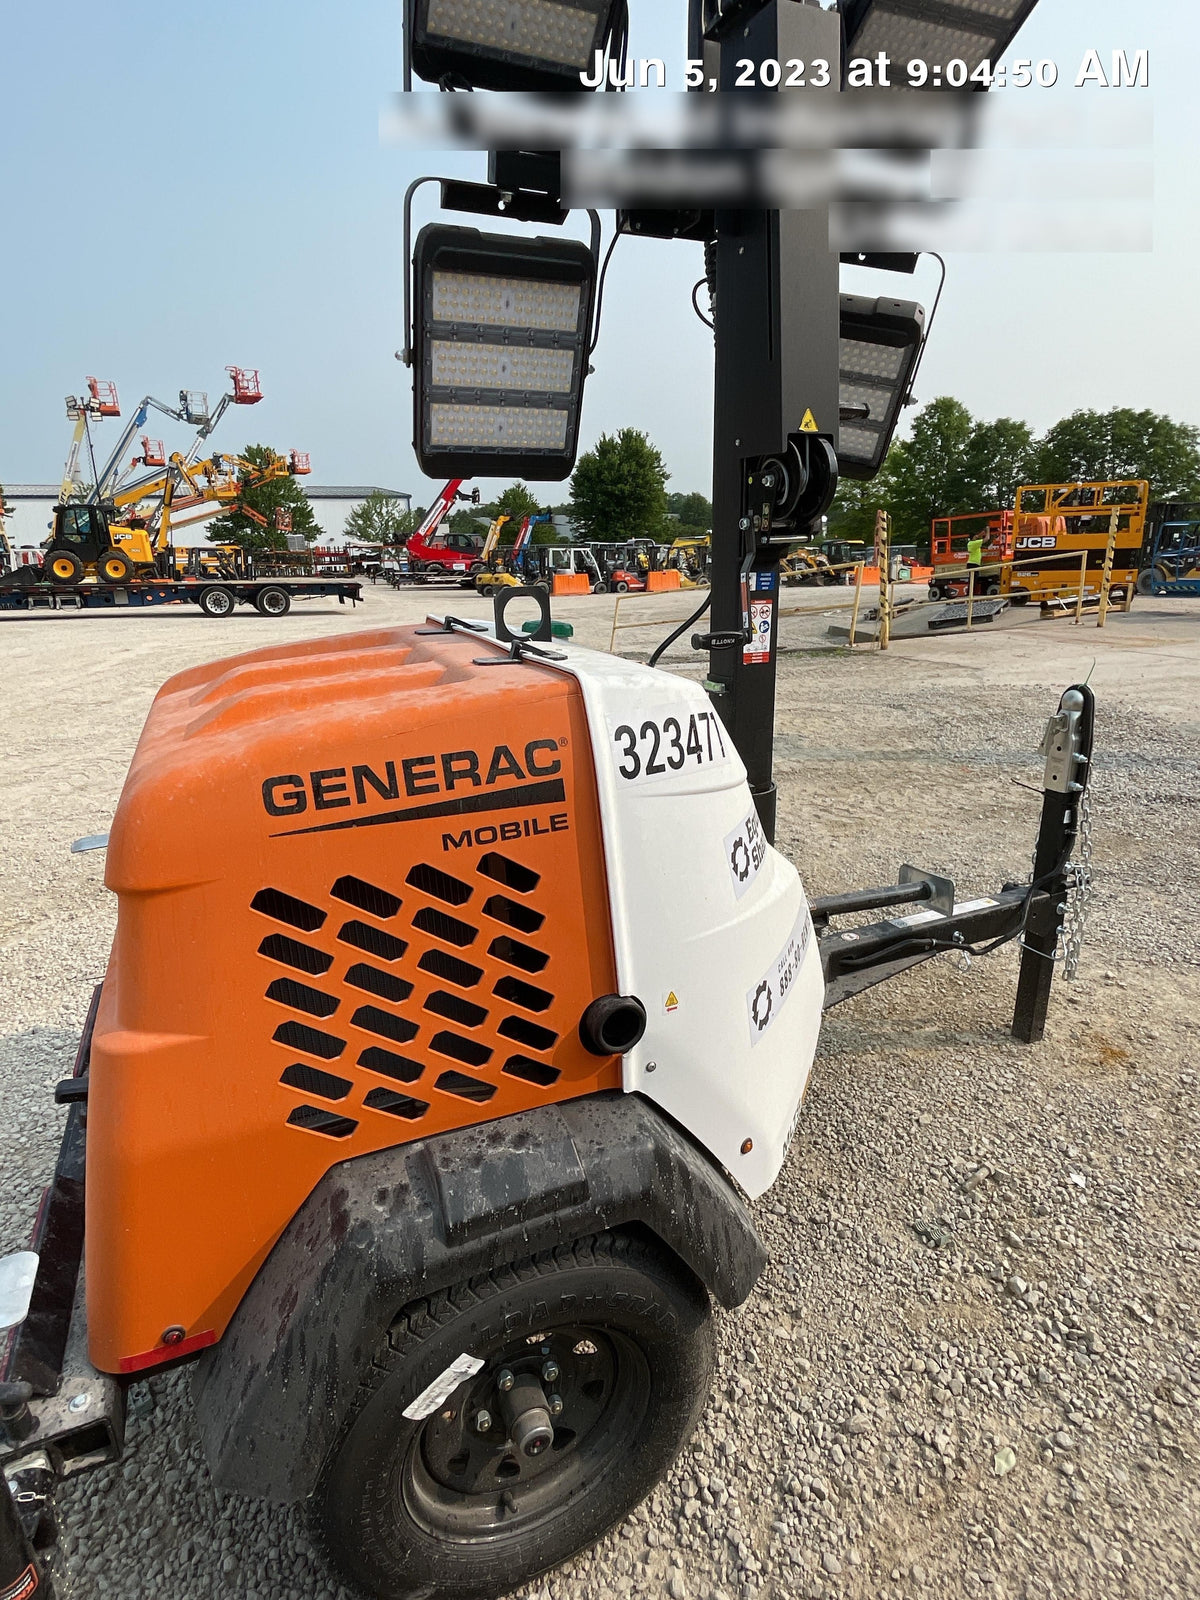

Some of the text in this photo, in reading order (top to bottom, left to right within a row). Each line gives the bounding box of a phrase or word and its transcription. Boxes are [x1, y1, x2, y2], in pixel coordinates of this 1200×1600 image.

[1015, 537, 1056, 548] JCB
[614, 712, 726, 780] 323471
[441, 813, 569, 851] MOBILE
